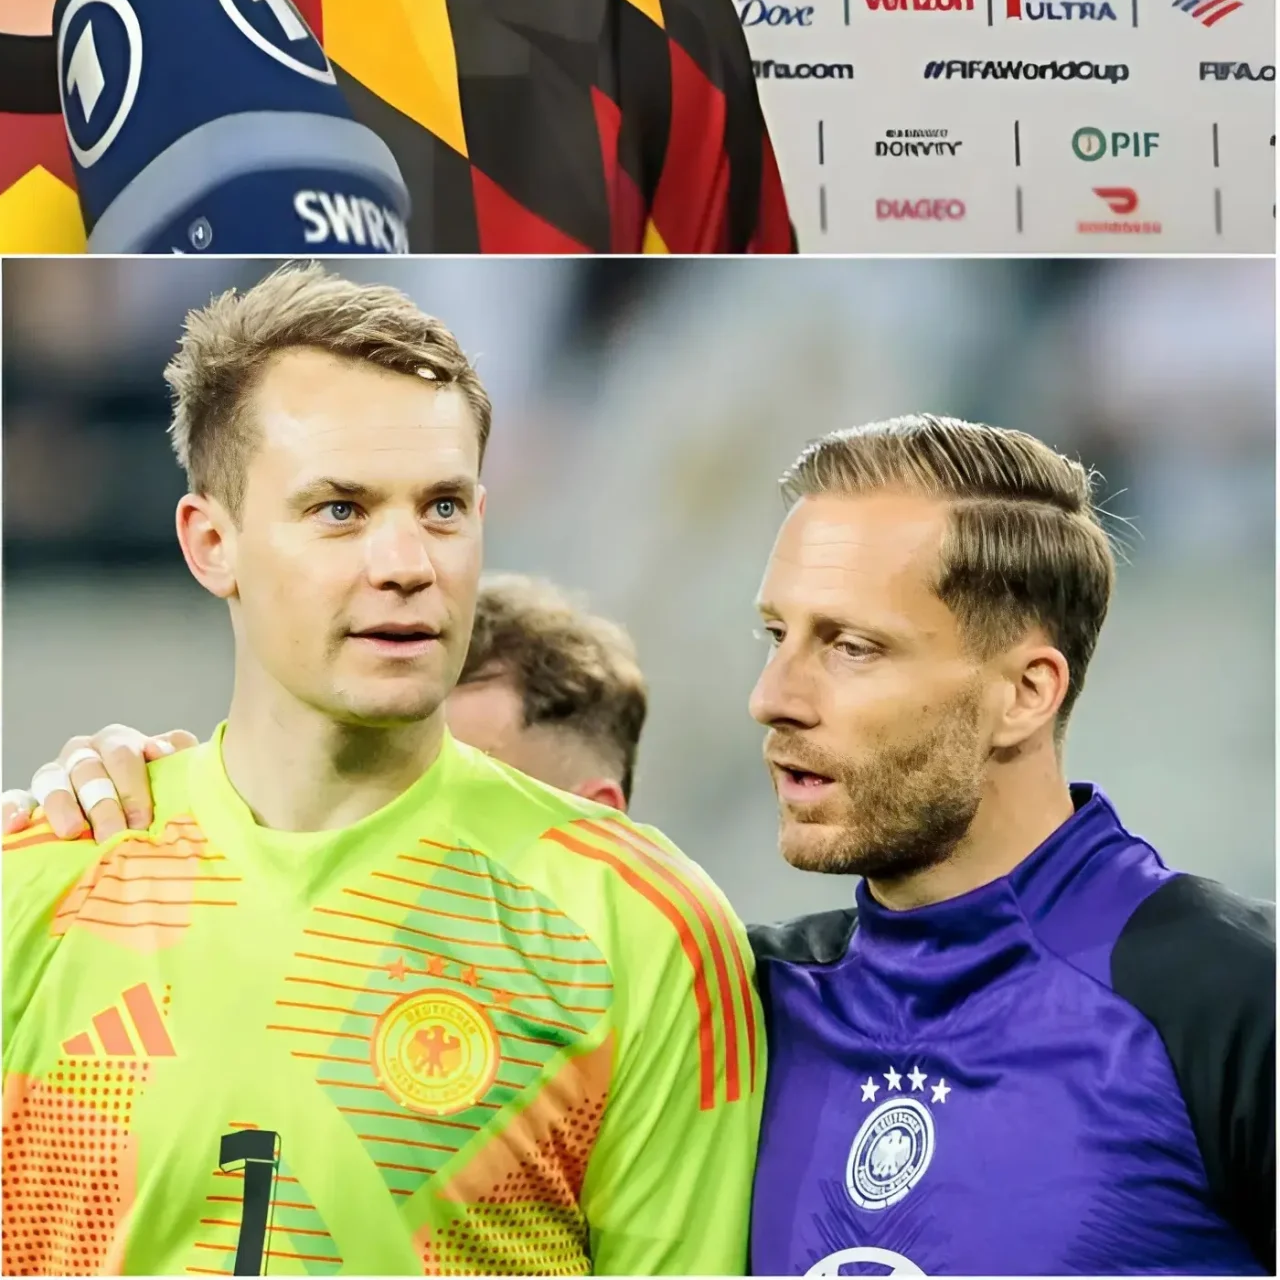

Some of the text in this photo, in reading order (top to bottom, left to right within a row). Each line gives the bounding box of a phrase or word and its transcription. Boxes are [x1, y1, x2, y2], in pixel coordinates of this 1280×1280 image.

[1026, 1, 1117, 21] ULTRA
[1112, 132, 1159, 157] PIF
[876, 199, 966, 220] DIAGEO
[219, 1129, 281, 1276] 1
